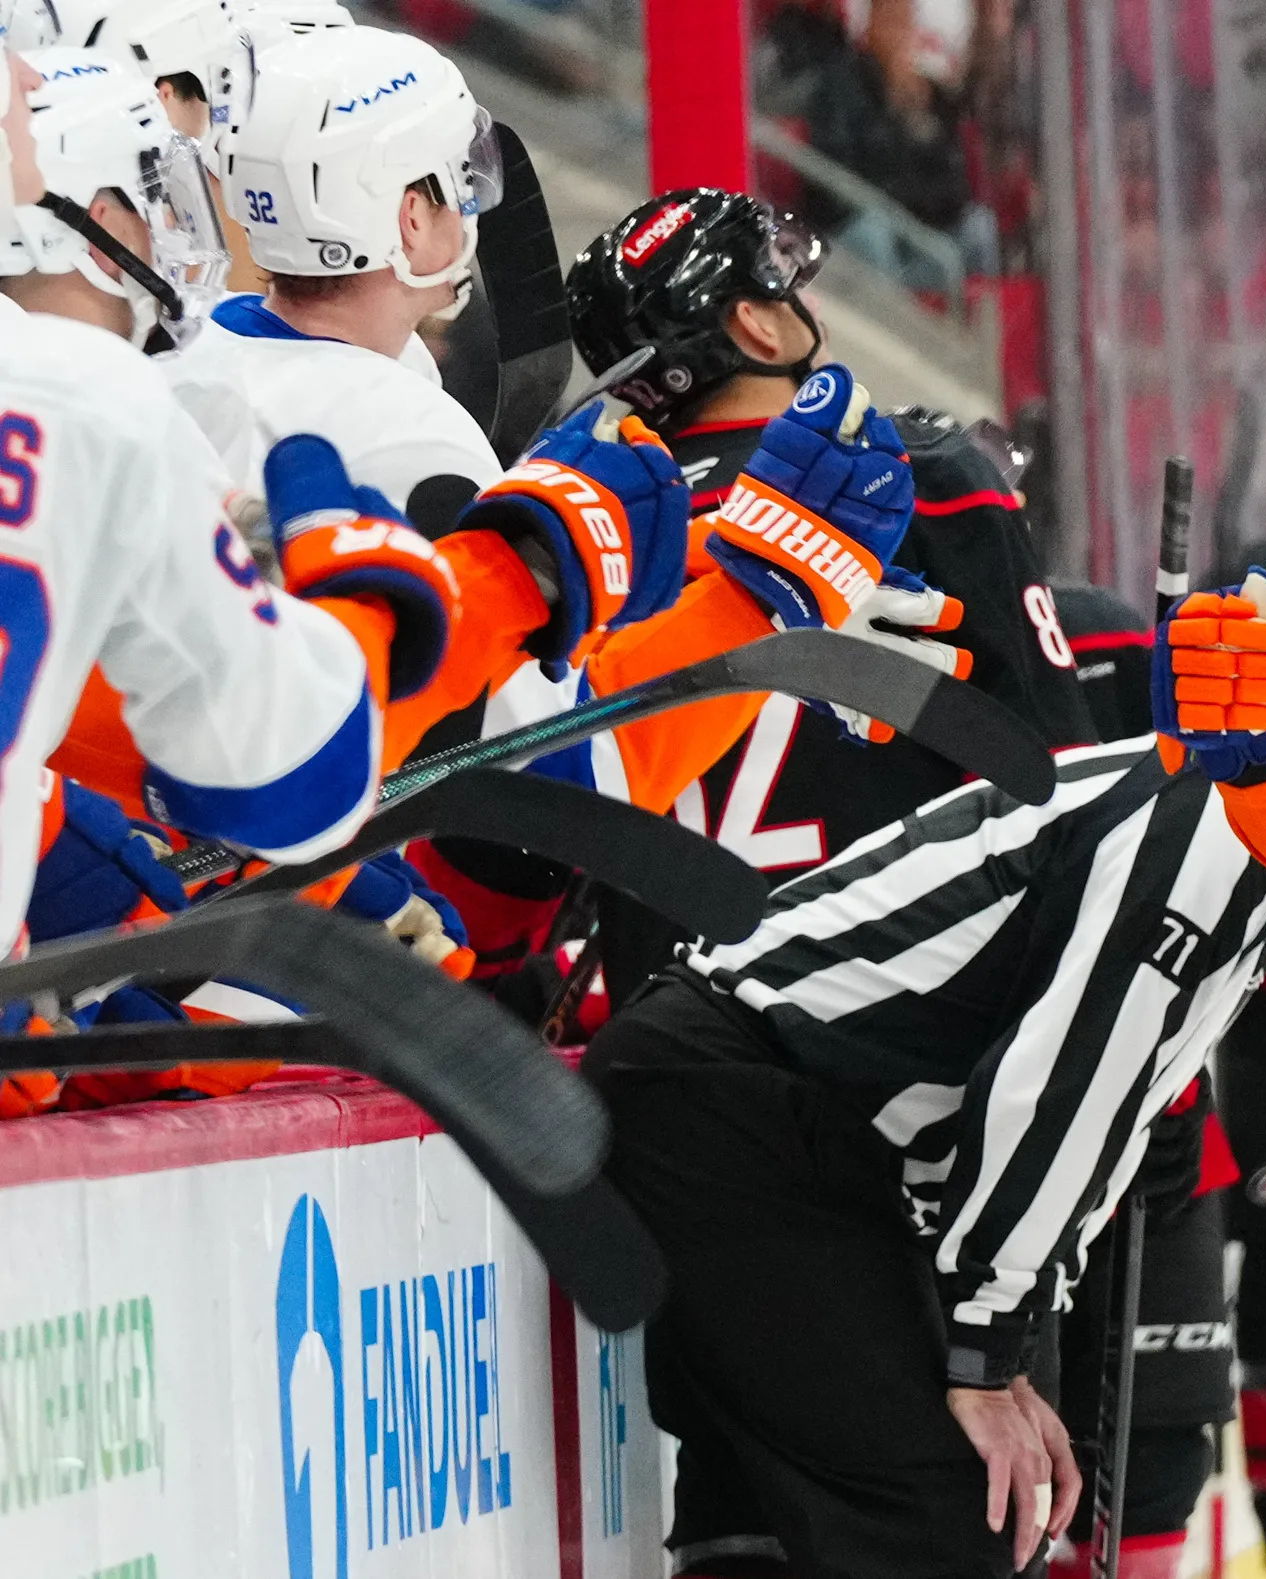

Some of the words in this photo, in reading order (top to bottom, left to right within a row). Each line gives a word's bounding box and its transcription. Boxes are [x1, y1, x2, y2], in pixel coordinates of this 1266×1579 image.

[335, 72, 417, 112] VIAM
[245, 189, 278, 225] 32
[1152, 916, 1199, 977] 71
[360, 1262, 512, 1550] FANDUEL
